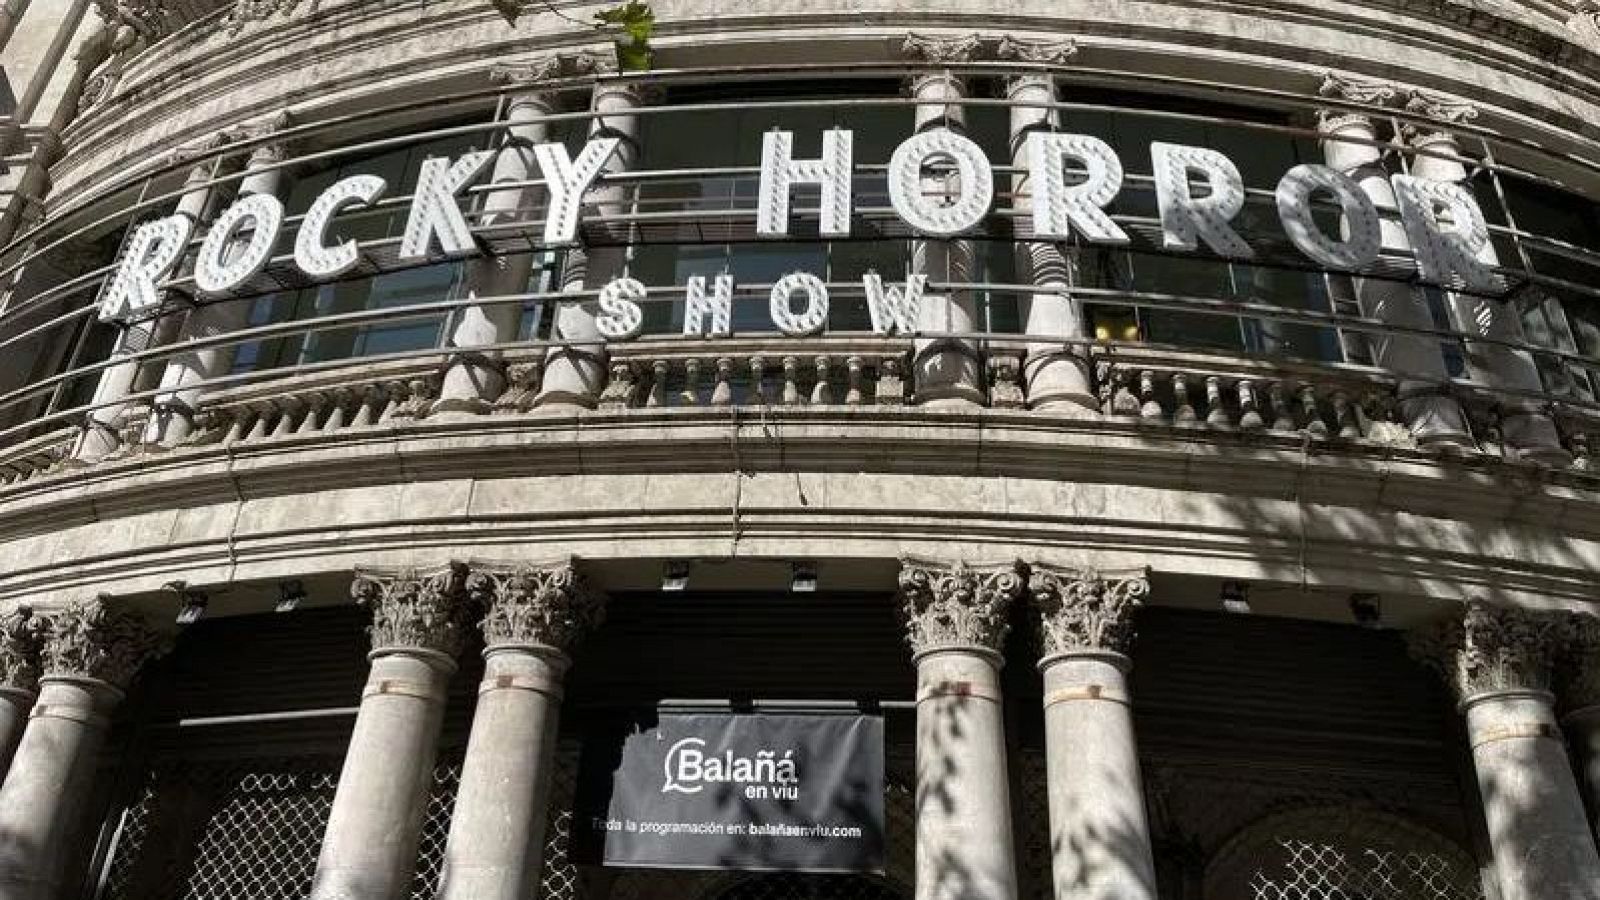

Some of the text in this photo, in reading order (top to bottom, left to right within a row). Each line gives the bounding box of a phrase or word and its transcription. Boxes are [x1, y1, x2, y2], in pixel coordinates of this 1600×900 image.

[97, 127, 1508, 323] ROCKY HORROR
[596, 272, 929, 337] SHOW
[678, 749, 798, 782] Balañá
[745, 785, 798, 799] en viu
[625, 819, 637, 832] la
[640, 821, 723, 836] programación
[727, 823, 746, 835] en:
